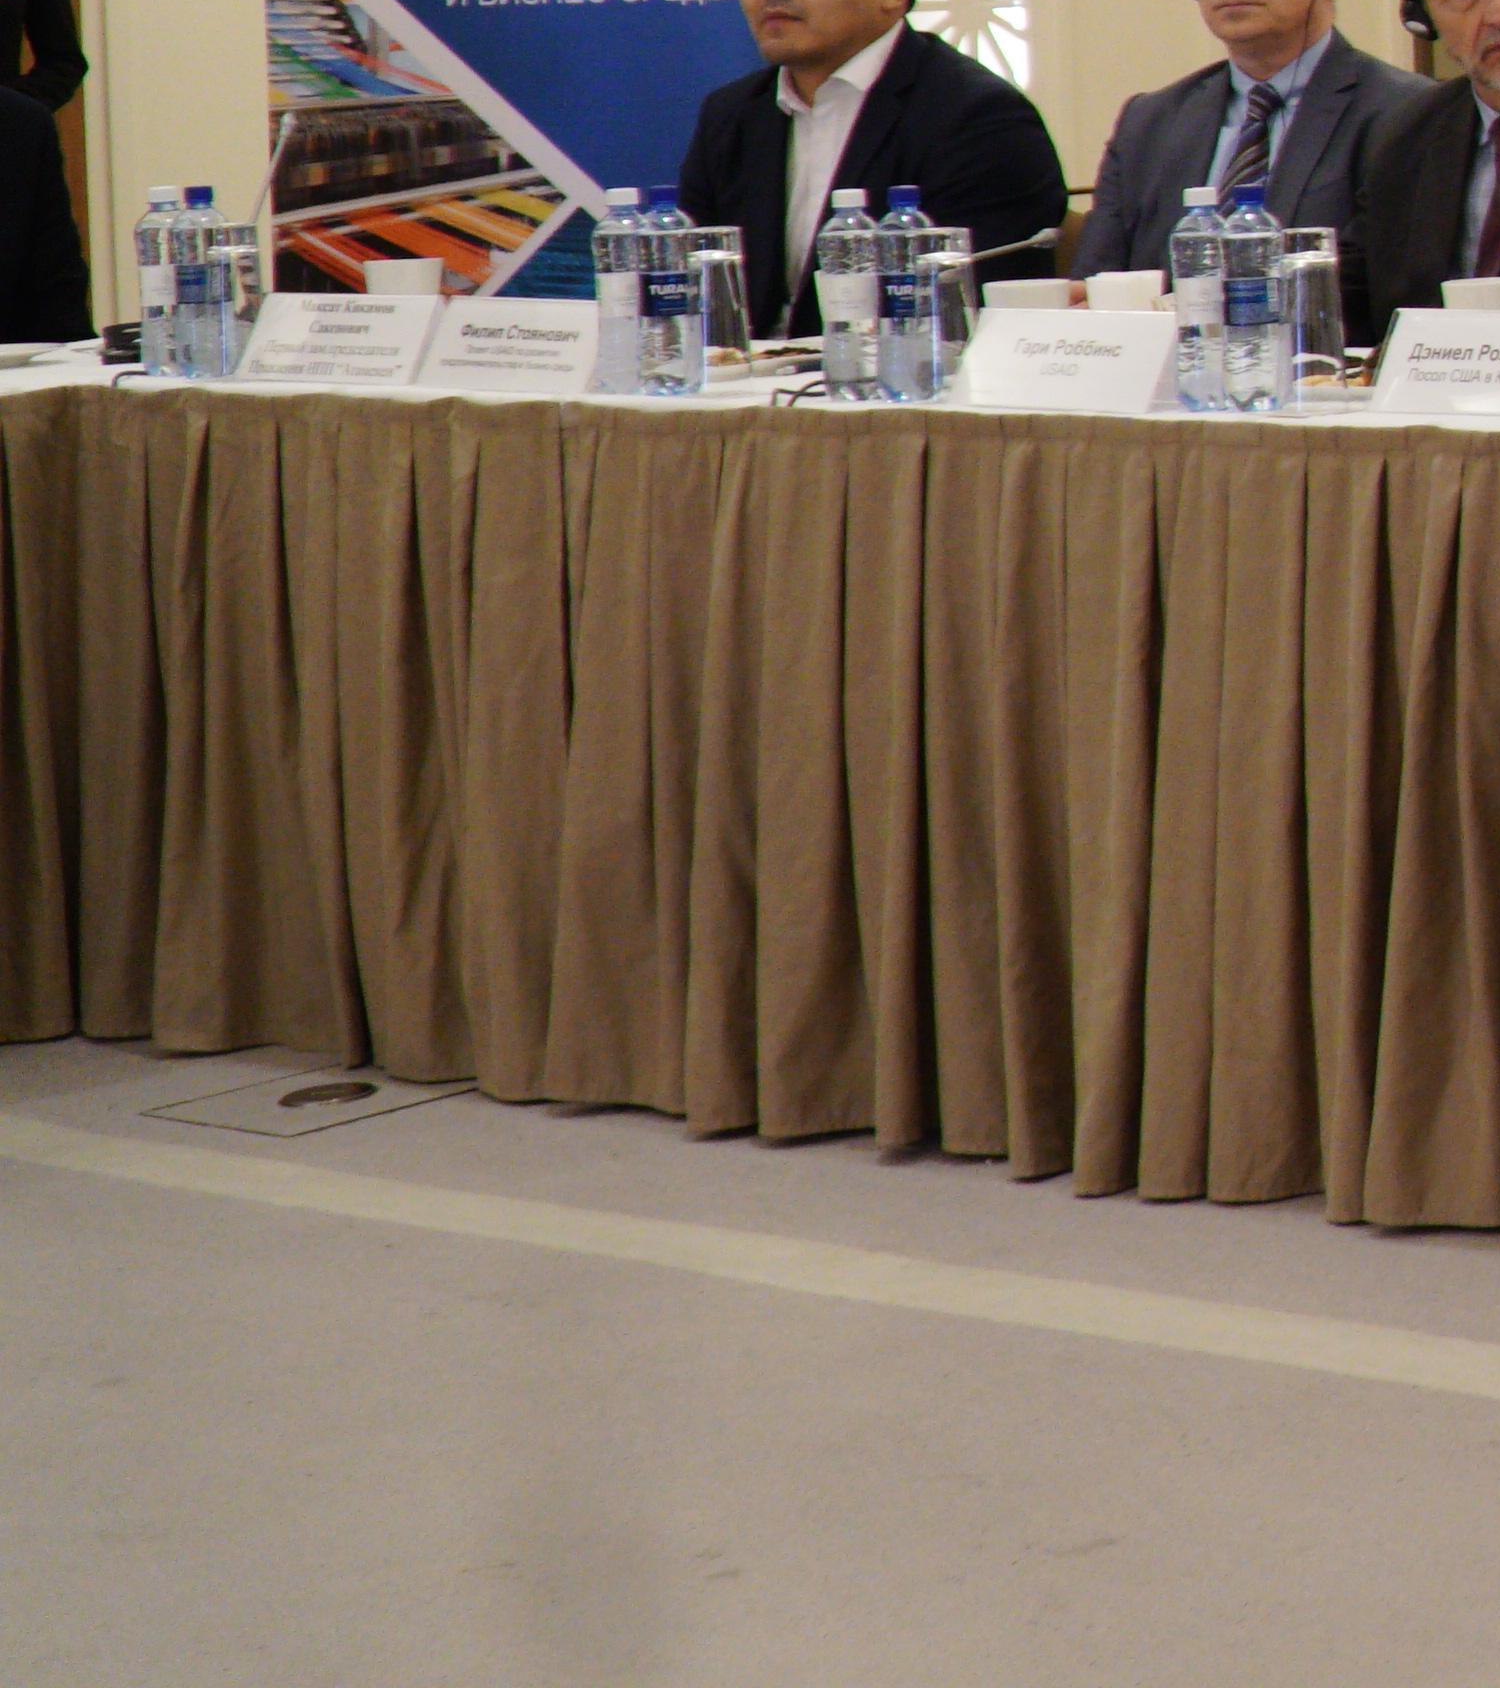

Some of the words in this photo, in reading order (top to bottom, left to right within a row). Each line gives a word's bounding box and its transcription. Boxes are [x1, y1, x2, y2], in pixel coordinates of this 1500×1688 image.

[1014, 338, 1050, 358] Гари
[1054, 338, 1122, 357] Роббинс
[1408, 343, 1473, 362] Дэниел
[1407, 367, 1447, 383] Посол
[1451, 368, 1481, 383] США
[1484, 373, 1492, 383] в
